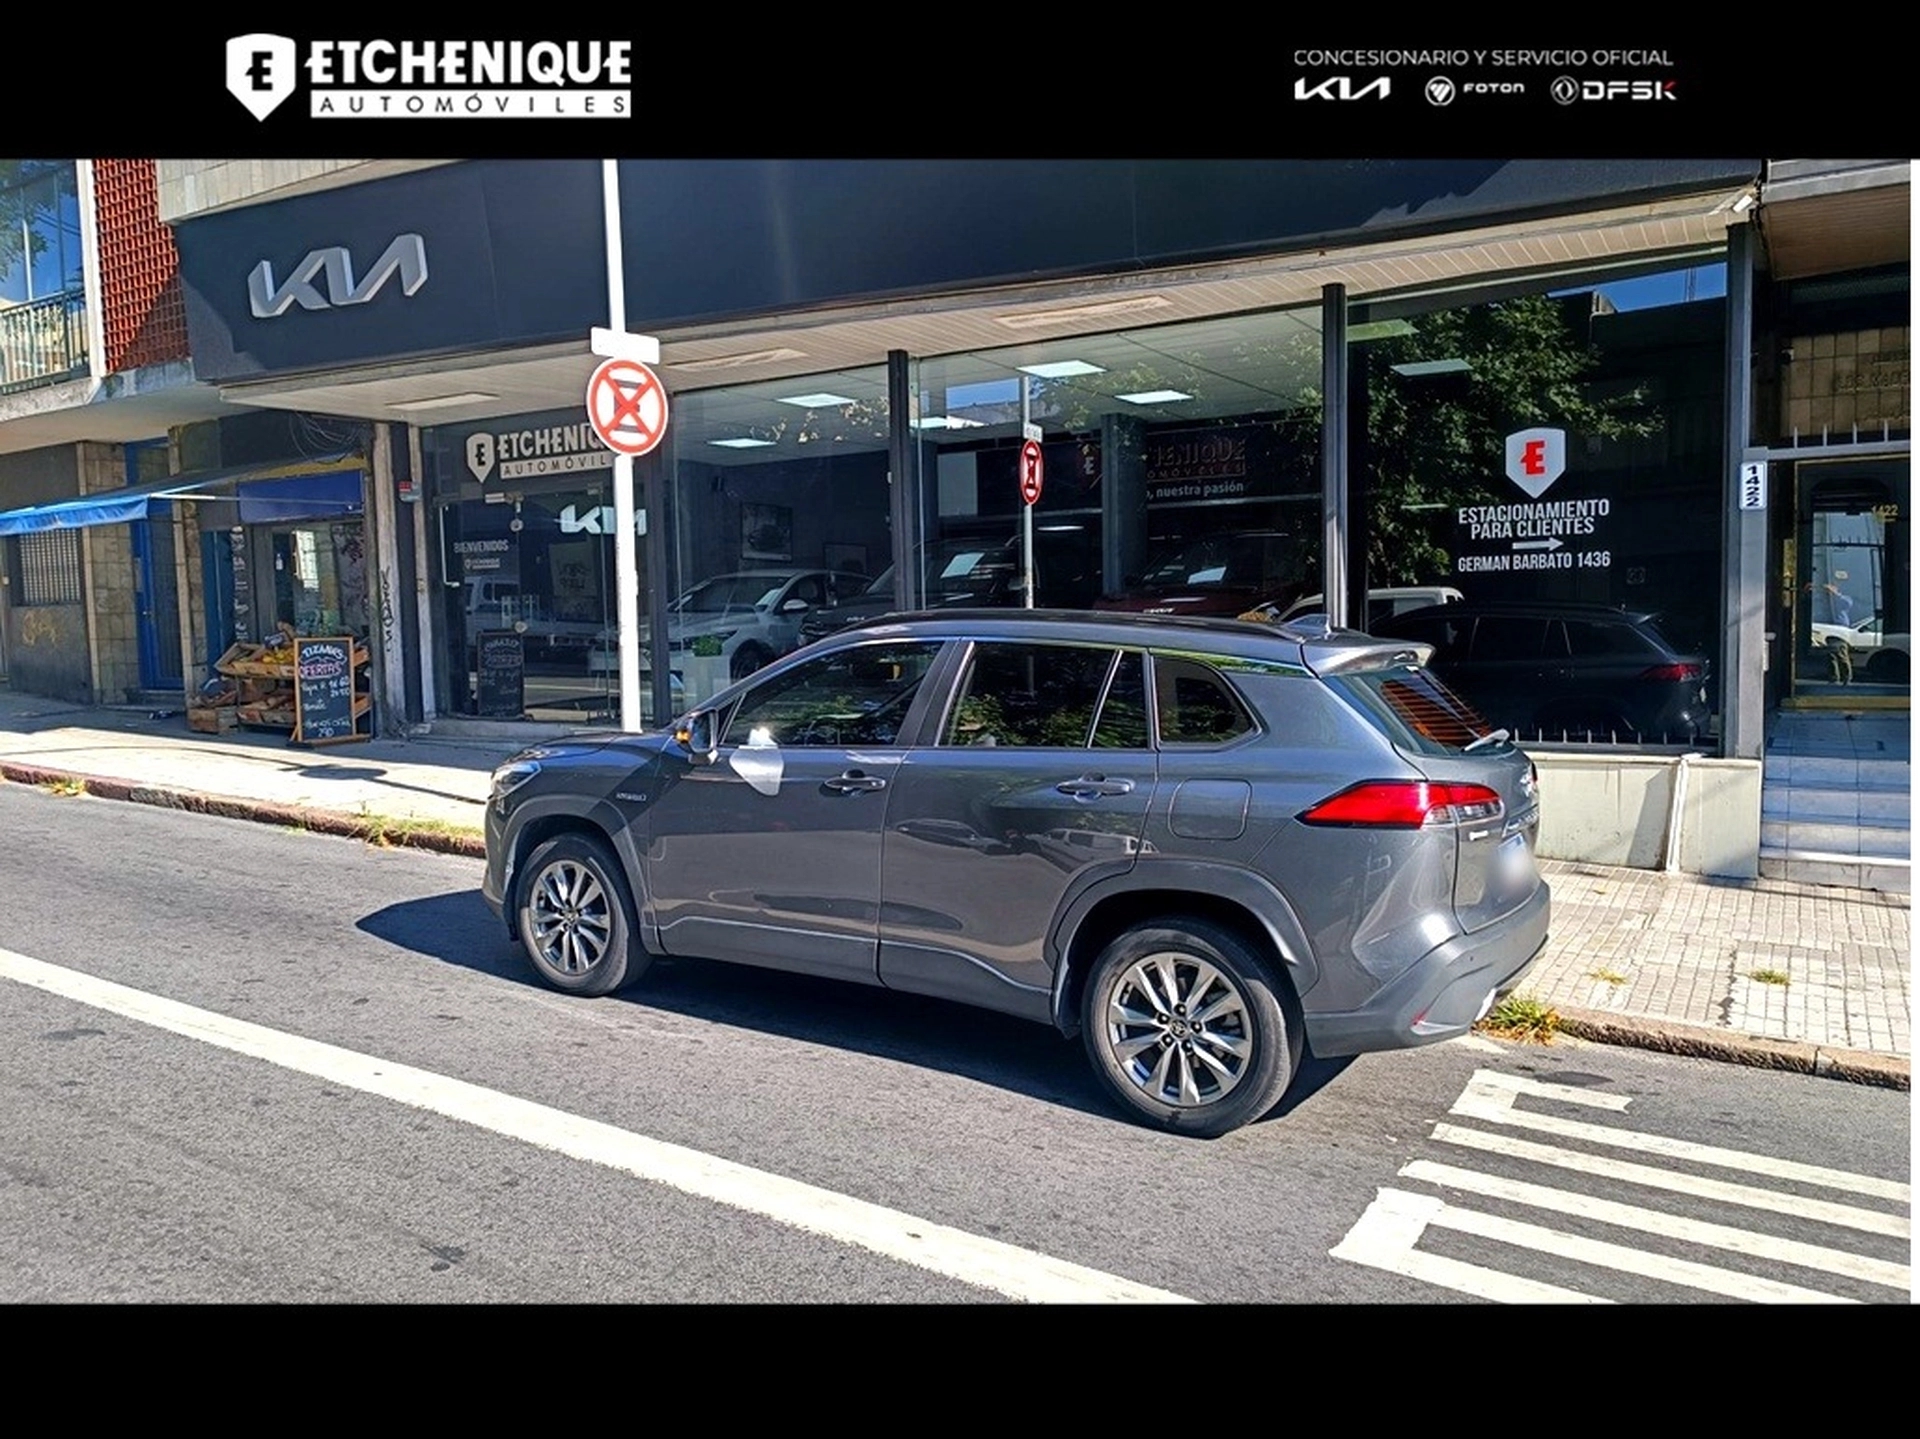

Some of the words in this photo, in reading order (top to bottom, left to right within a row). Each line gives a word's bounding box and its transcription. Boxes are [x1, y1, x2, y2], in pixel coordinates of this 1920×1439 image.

[497, 423, 605, 460] ETCHENIQ
[503, 456, 606, 476] AUTOMÓVIL
[1156, 484, 1201, 498] nuestra
[1203, 480, 1244, 497] pasión
[1458, 499, 1610, 525] ESTACIONAMIENTO
[1871, 504, 1899, 517] 1422
[1471, 522, 1513, 540] PARA
[1516, 517, 1595, 538] CLIENTES
[1458, 554, 1510, 572] GERMAN
[1512, 552, 1573, 571] BARBATO
[1577, 550, 1611, 568] 1436
